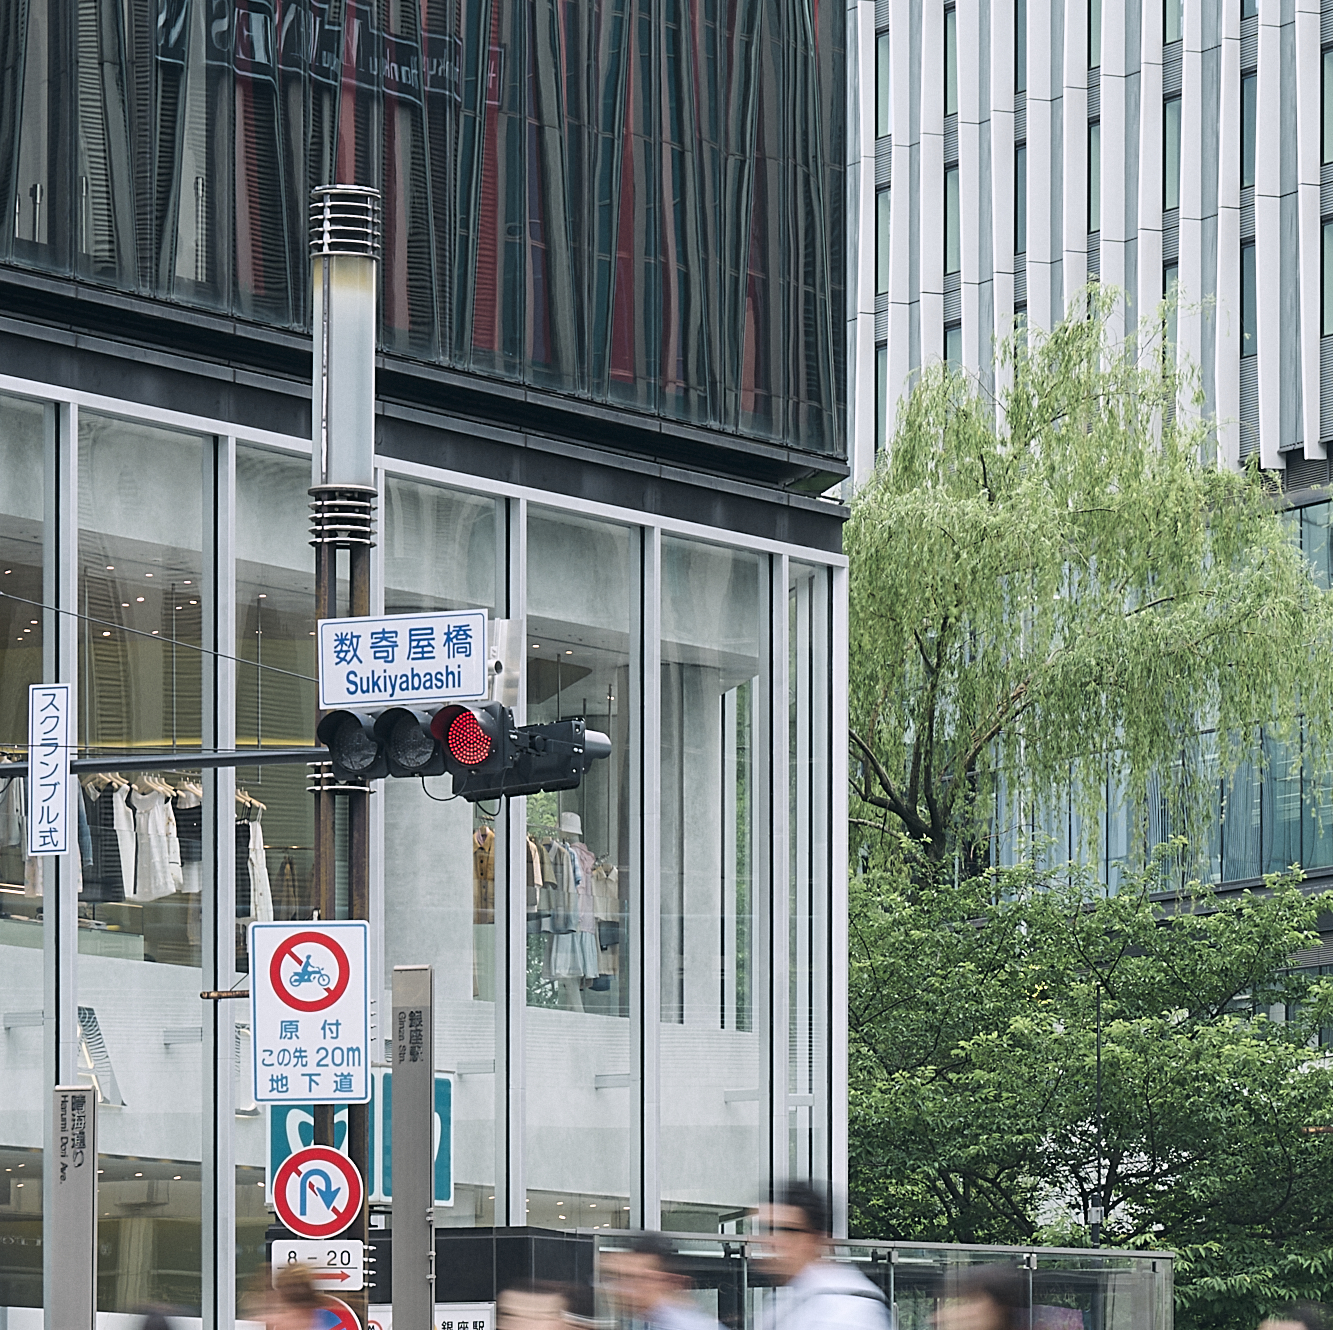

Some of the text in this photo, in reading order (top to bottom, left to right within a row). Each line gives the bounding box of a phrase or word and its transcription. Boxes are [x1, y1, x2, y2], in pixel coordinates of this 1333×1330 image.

[334, 624, 473, 666] 数寄屋橋
[346, 664, 462, 698] Sukiyabashi
[38, 693, 61, 848] スクランブル式
[279, 1019, 342, 1040] 原付
[262, 1046, 361, 1068] この先 20m
[269, 1072, 354, 1094] 地下道
[60, 1094, 69, 1184] Harumi Dori Ave.
